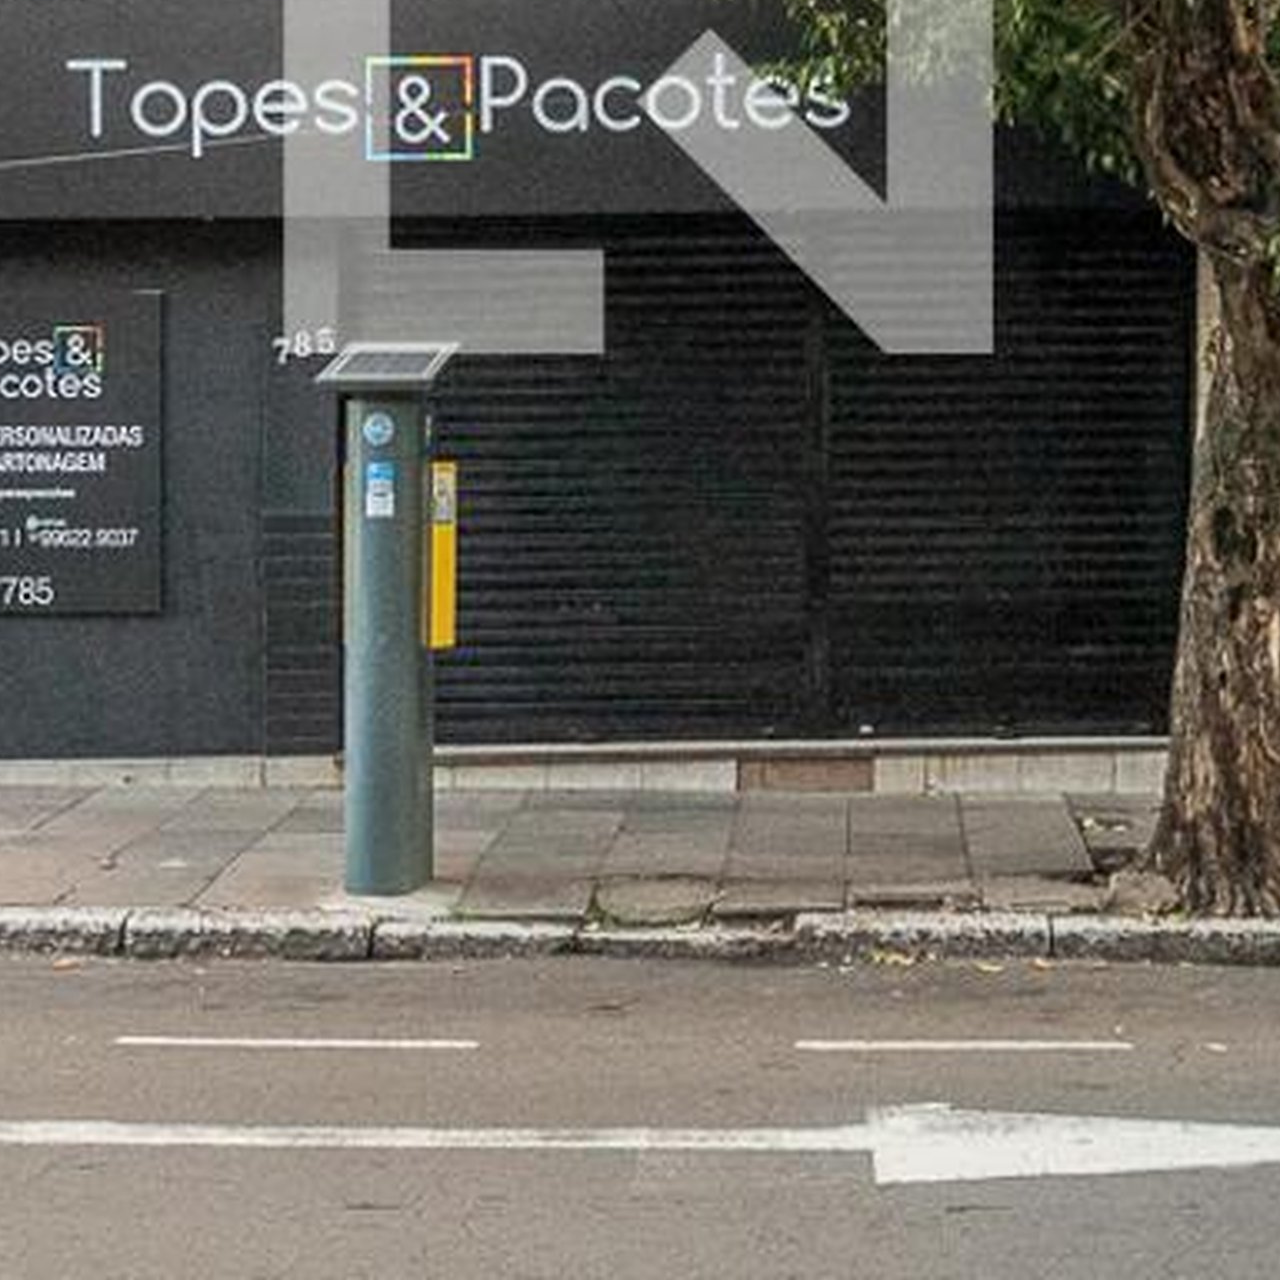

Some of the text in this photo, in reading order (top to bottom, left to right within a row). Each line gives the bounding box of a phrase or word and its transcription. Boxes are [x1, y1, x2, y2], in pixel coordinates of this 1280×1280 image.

[66, 52, 851, 158] Topes & Pacotes
[65, 333, 94, 366] &
[273, 327, 337, 365] 785
